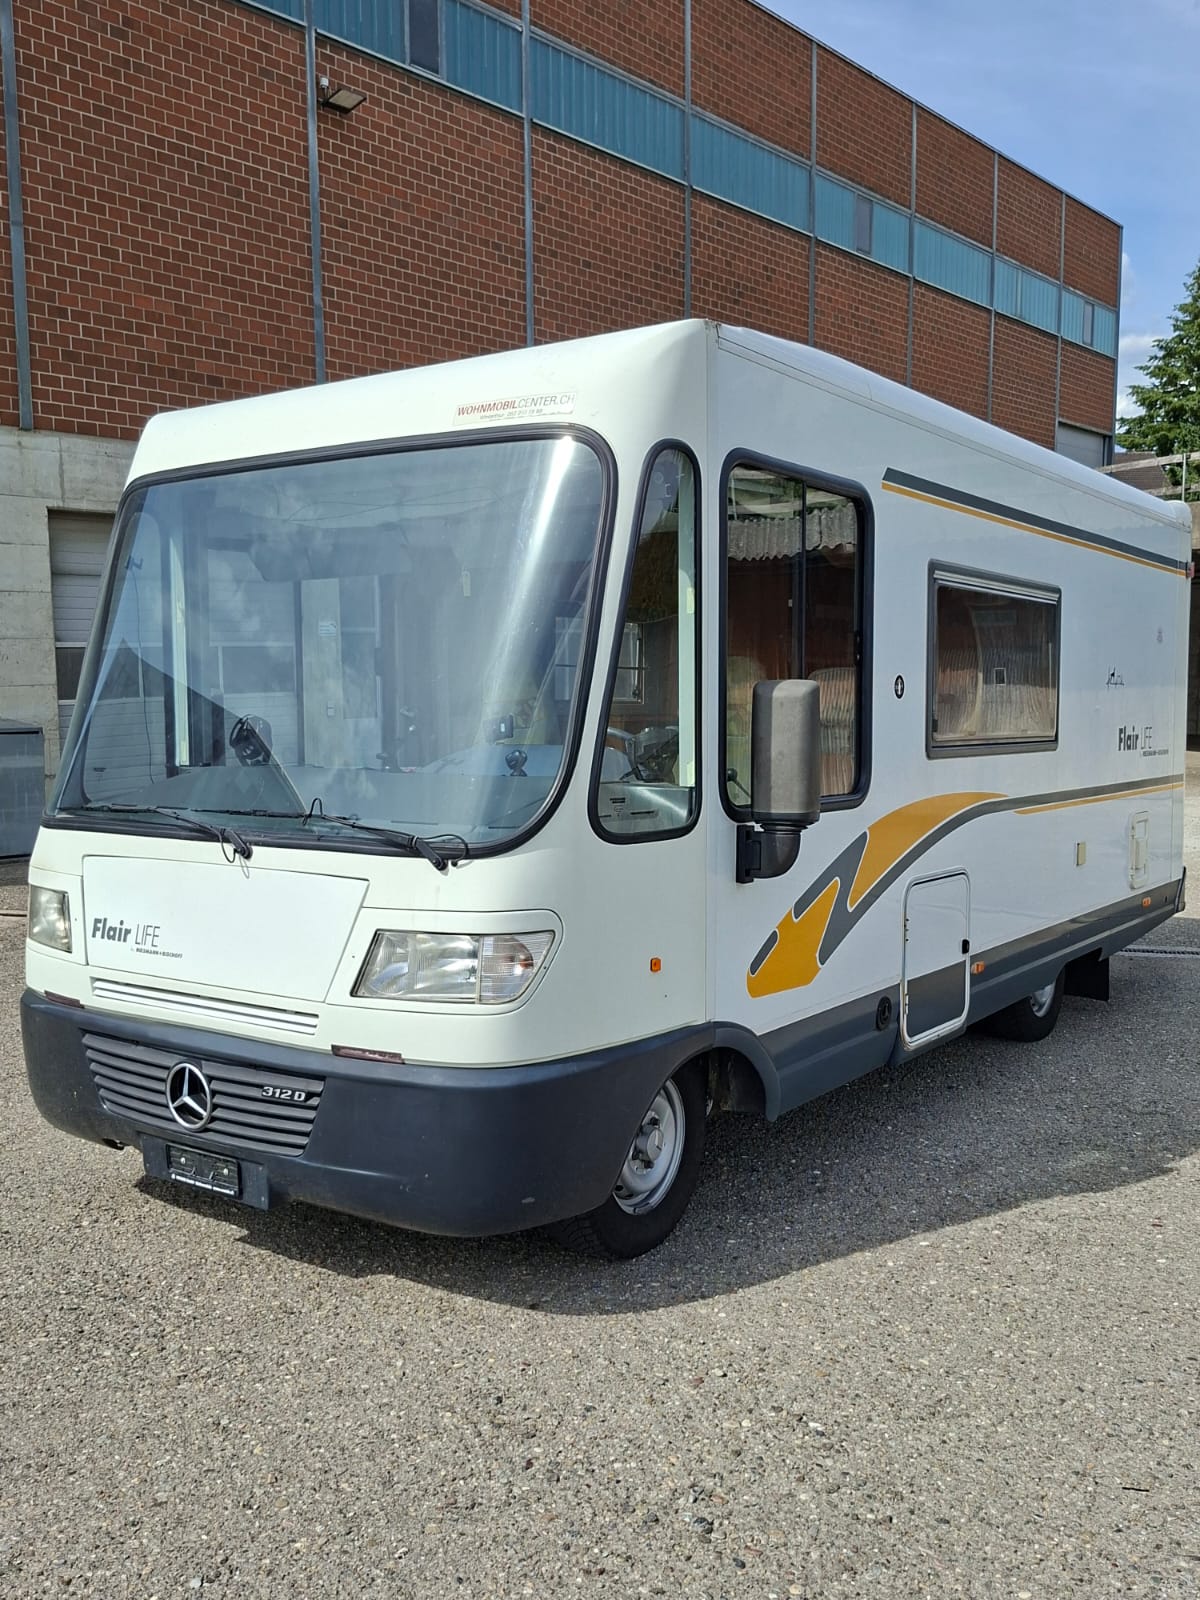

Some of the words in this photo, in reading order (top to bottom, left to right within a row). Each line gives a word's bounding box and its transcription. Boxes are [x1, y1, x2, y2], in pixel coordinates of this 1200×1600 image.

[457, 394, 575, 416] WOHNMOBILCENTER.CH
[1118, 725, 1139, 751] Flair
[91, 917, 132, 943] Flair
[134, 923, 161, 948] LIFE
